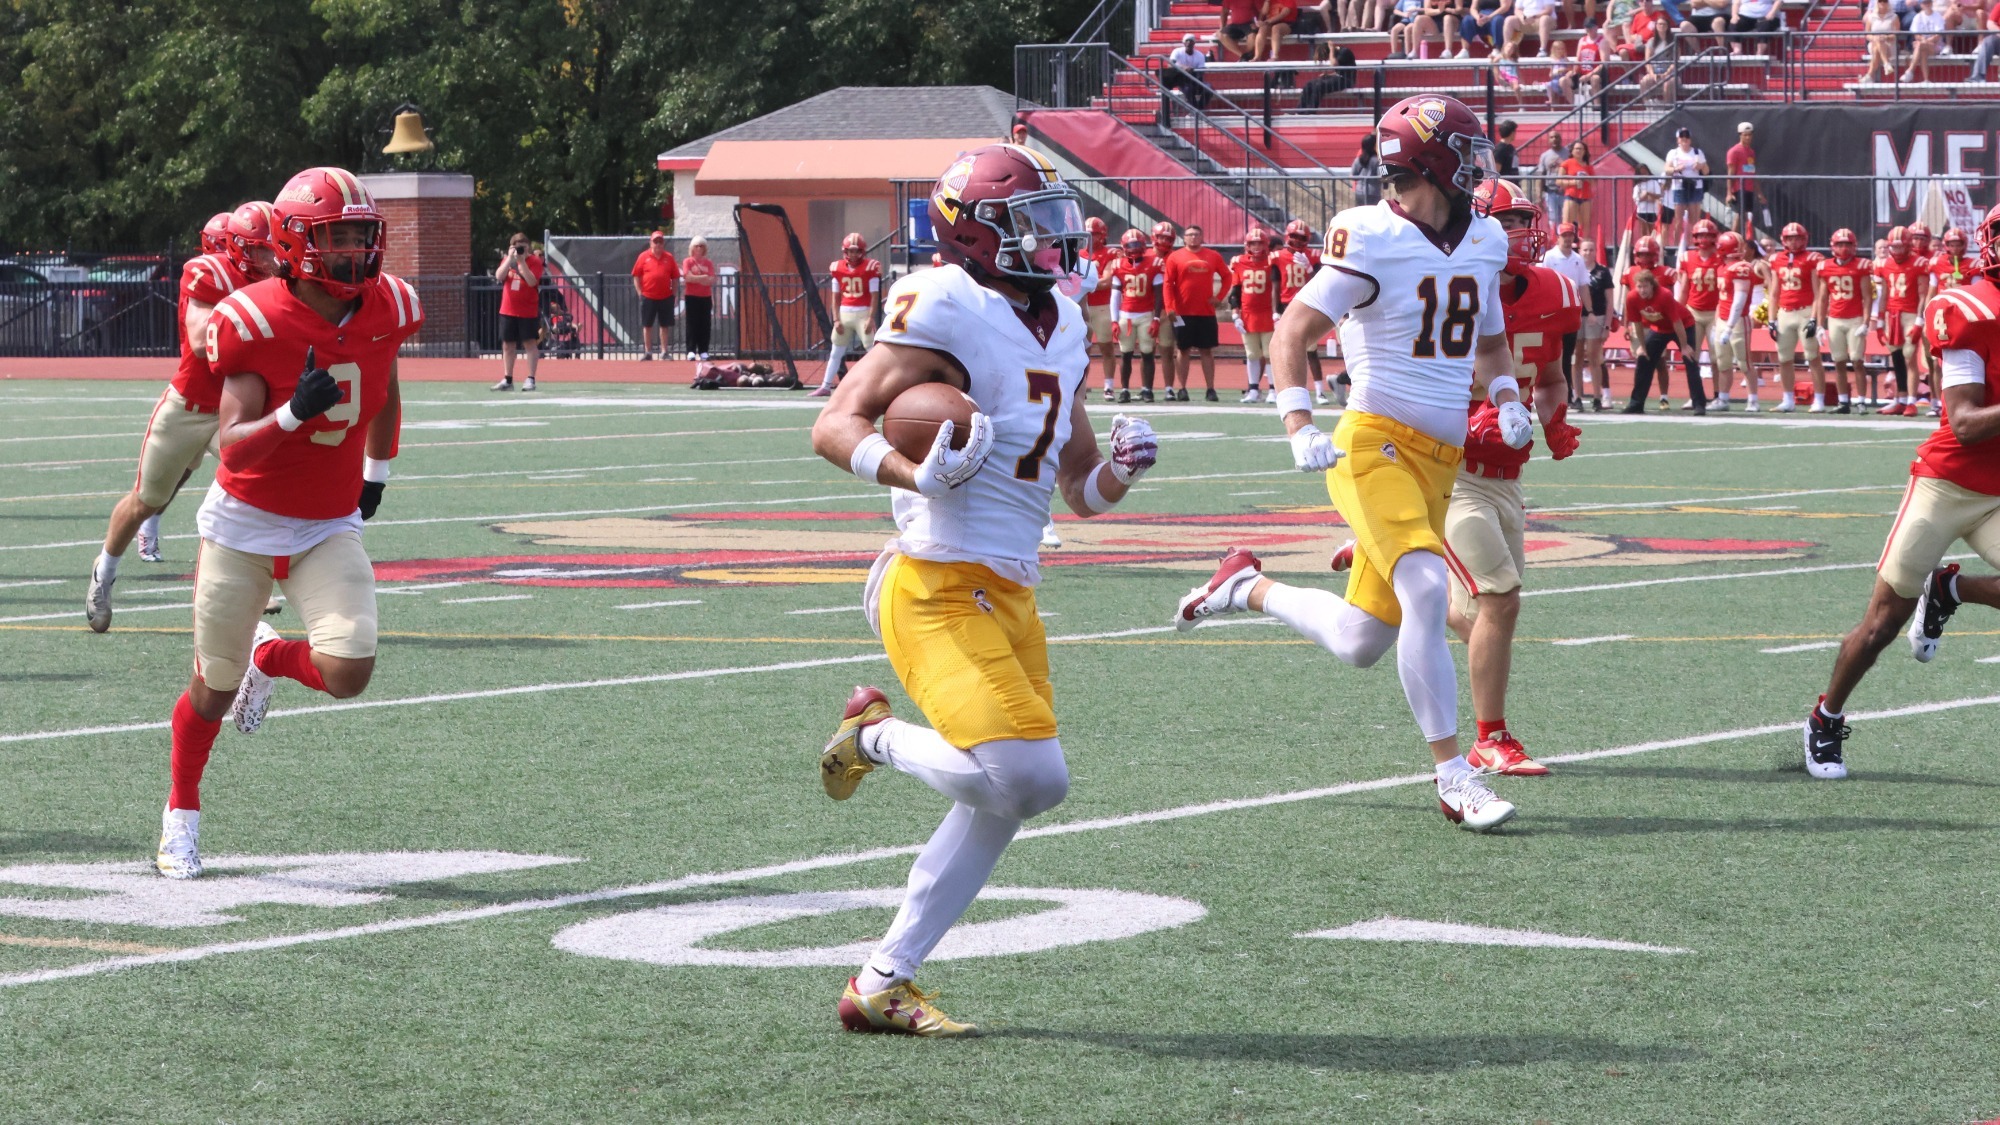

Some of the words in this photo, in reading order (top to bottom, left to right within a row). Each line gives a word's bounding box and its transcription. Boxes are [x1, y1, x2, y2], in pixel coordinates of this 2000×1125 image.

[1873, 131, 2000, 226] ME
[1944, 190, 1966, 205] NO
[1325, 226, 1350, 260] 18
[187, 266, 205, 292] 7
[841, 276, 864, 298] 30
[1124, 273, 1148, 298] 20
[1242, 269, 1267, 294] 29
[1285, 263, 1306, 289] 18
[1691, 267, 1716, 292] 44
[1828, 275, 1854, 300] 39
[1889, 273, 1907, 298] 14
[890, 291, 920, 334] 7
[1412, 275, 1480, 358] 18
[1933, 308, 1949, 341] 4
[206, 323, 219, 362] 9
[1513, 332, 1544, 402] 5
[310, 362, 361, 447] 9
[1014, 368, 1061, 482] 7
